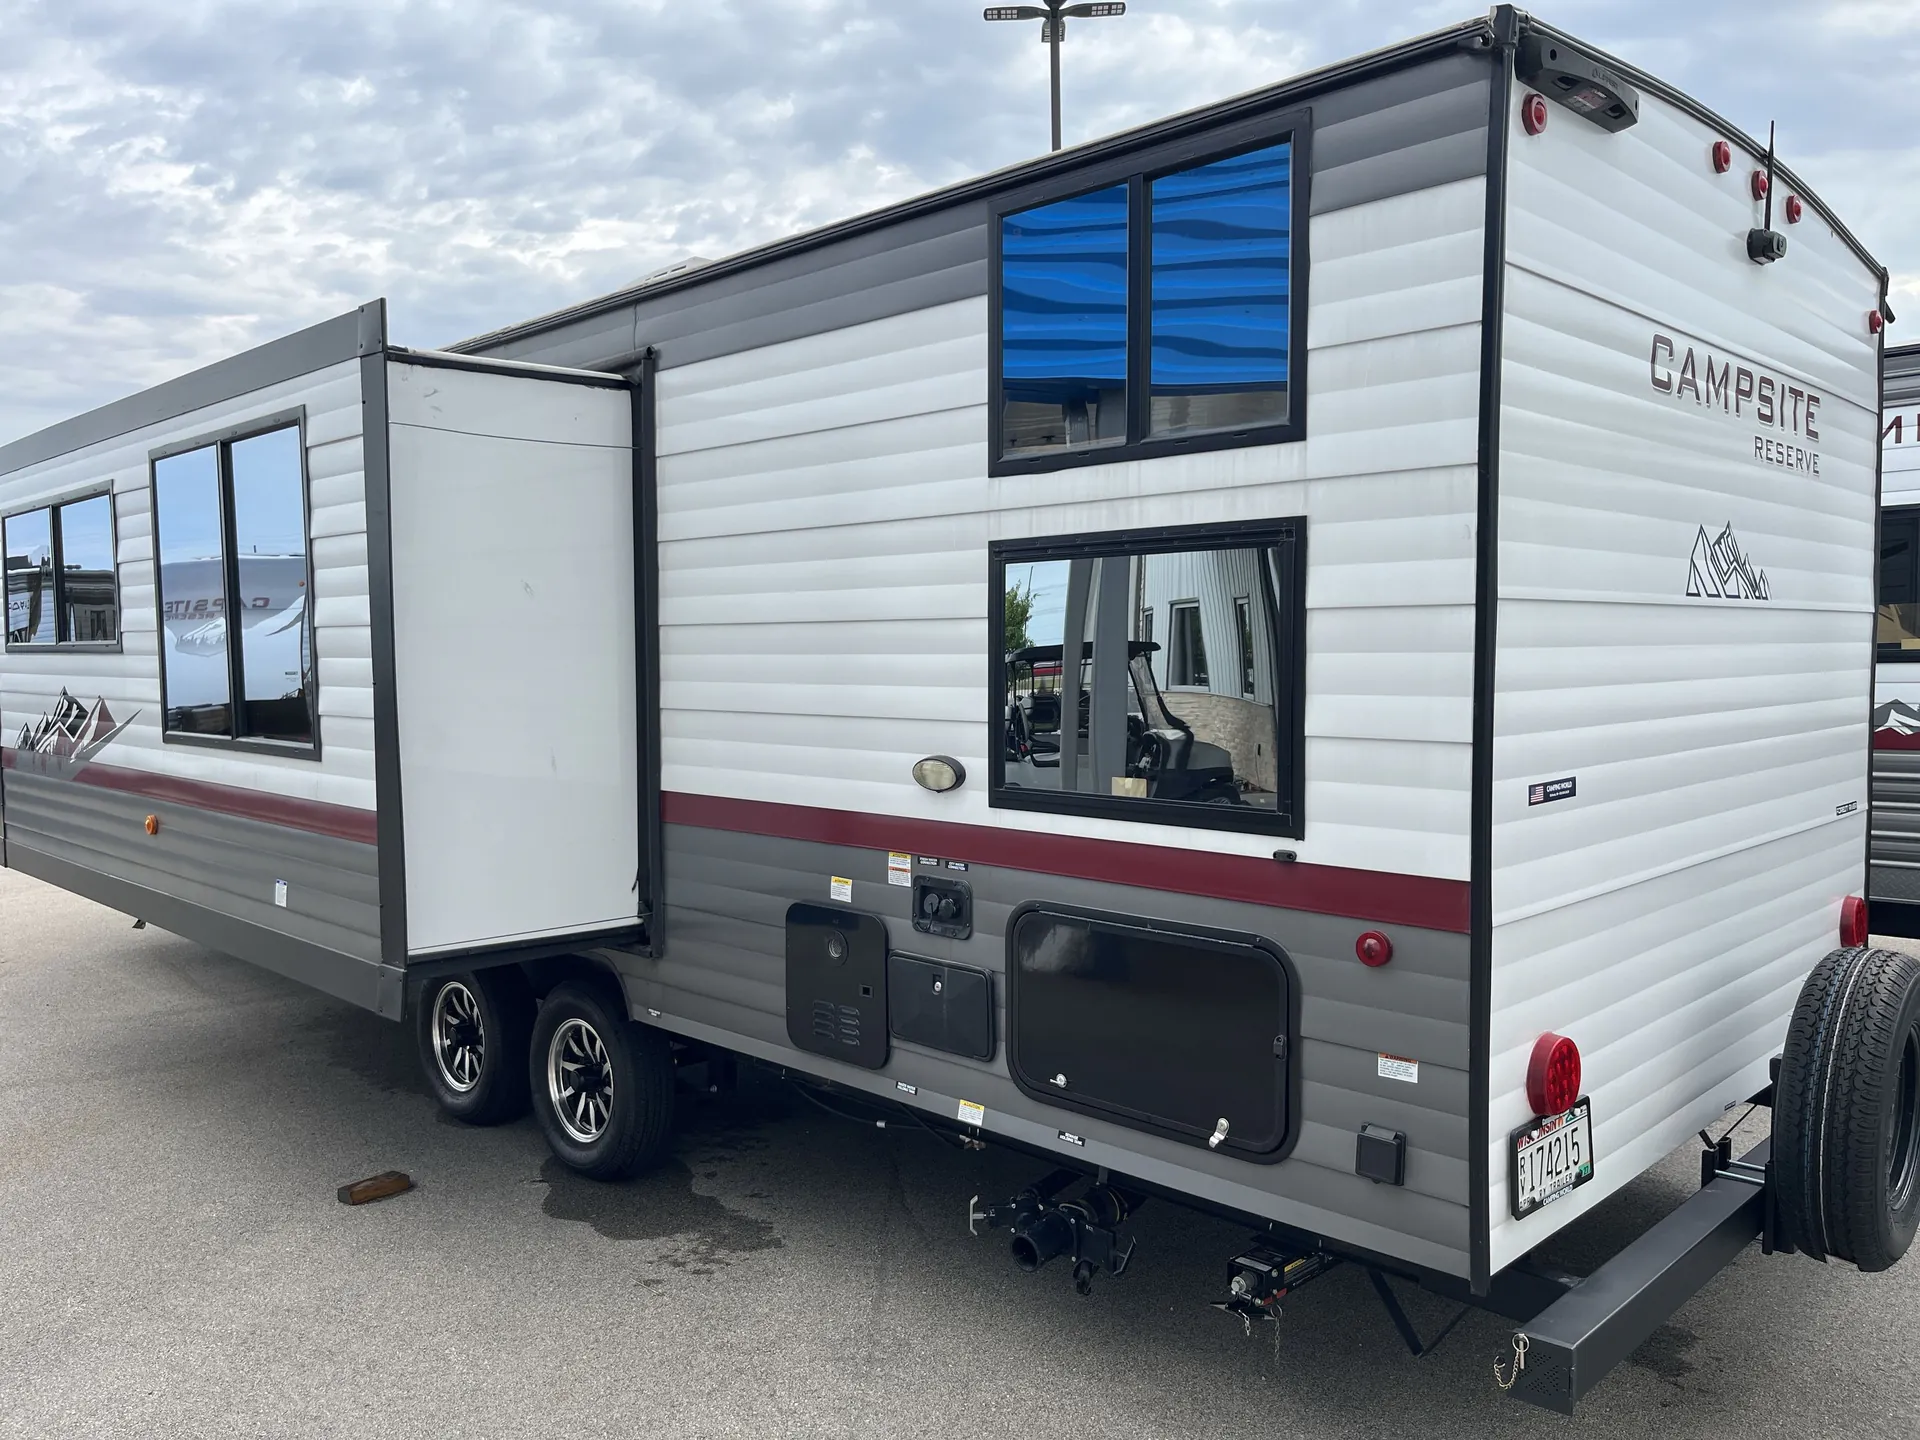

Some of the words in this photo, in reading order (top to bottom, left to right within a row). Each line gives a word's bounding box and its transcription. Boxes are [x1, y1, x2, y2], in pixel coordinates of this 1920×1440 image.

[1650, 333, 1820, 440] CAMPSITE
[1754, 435, 1820, 475] RESERVE
[1529, 1126, 1580, 1193] 174215
[1549, 1172, 1573, 1191] TRAILER
